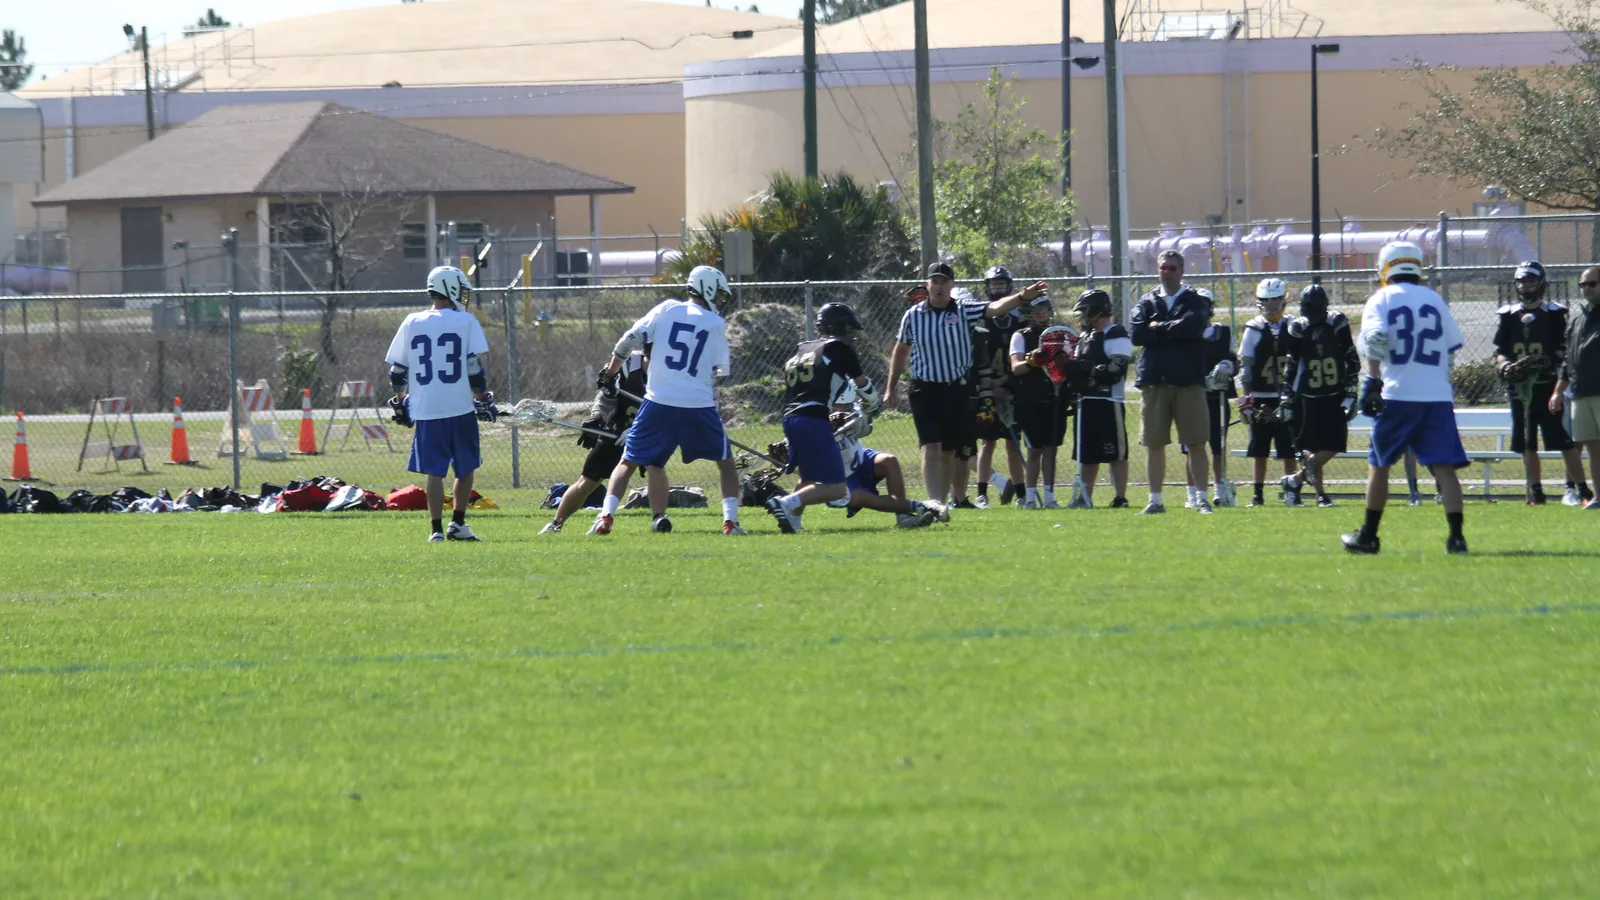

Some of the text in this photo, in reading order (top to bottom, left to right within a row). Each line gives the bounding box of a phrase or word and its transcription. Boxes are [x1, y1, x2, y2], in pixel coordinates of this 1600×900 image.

[411, 333, 462, 386] 33
[664, 321, 709, 377] 51
[1387, 304, 1443, 367] 32
[1308, 357, 1338, 388] 39
